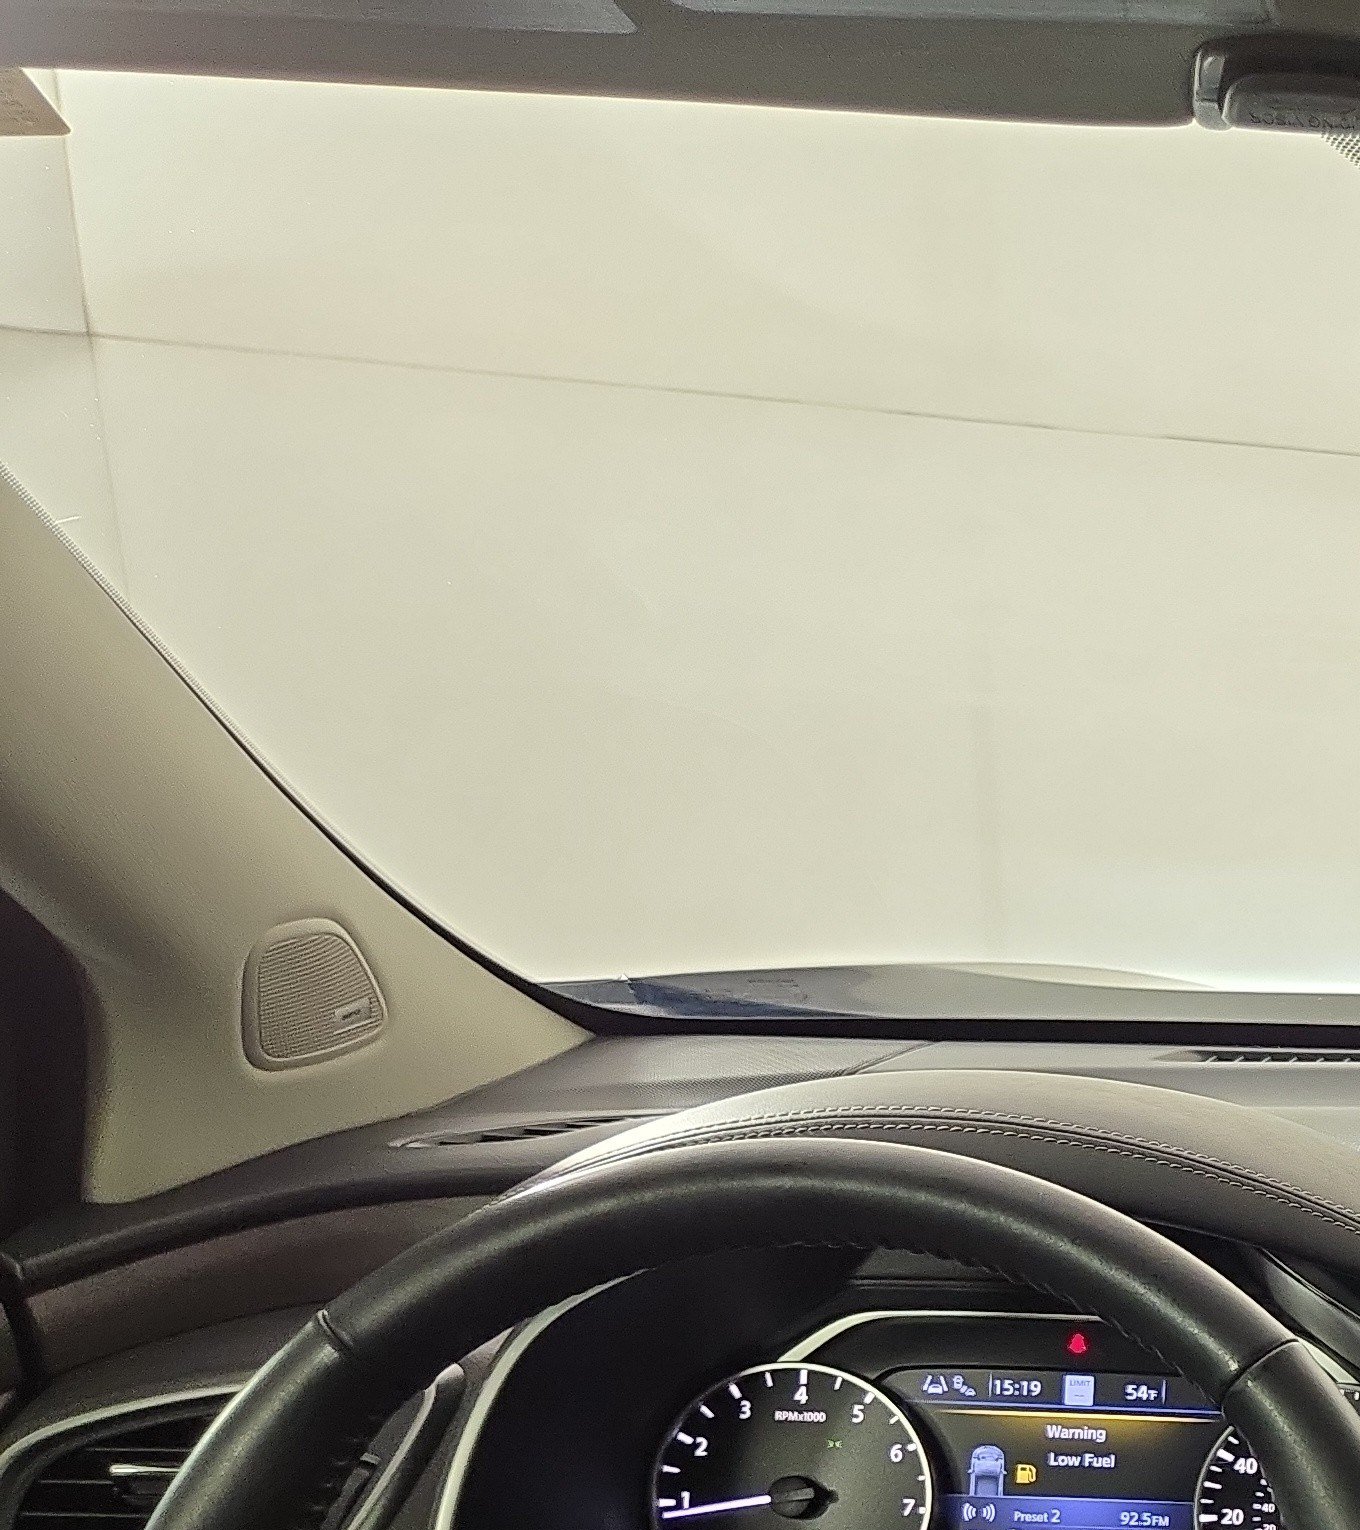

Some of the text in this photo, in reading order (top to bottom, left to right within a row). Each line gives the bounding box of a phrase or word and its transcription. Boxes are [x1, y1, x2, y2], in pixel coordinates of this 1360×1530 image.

[993, 1379, 1042, 1397] 15:19
[1069, 1379, 1091, 1387] LIMIT
[793, 1386, 808, 1404] 4
[739, 1400, 751, 1419] 3
[851, 1405, 864, 1423] 5
[1046, 1425, 1107, 1443] Warning
[694, 1437, 708, 1456] 2
[889, 1444, 903, 1462] 6
[1049, 1452, 1115, 1468] Low Fuel
[1234, 1457, 1258, 1475] 40
[680, 1491, 690, 1508] 1
[902, 1499, 915, 1516] 7
[1261, 1503, 1276, 1513] 40
[1014, 1510, 1061, 1523] Preset 2
[1220, 1508, 1244, 1525] 20
